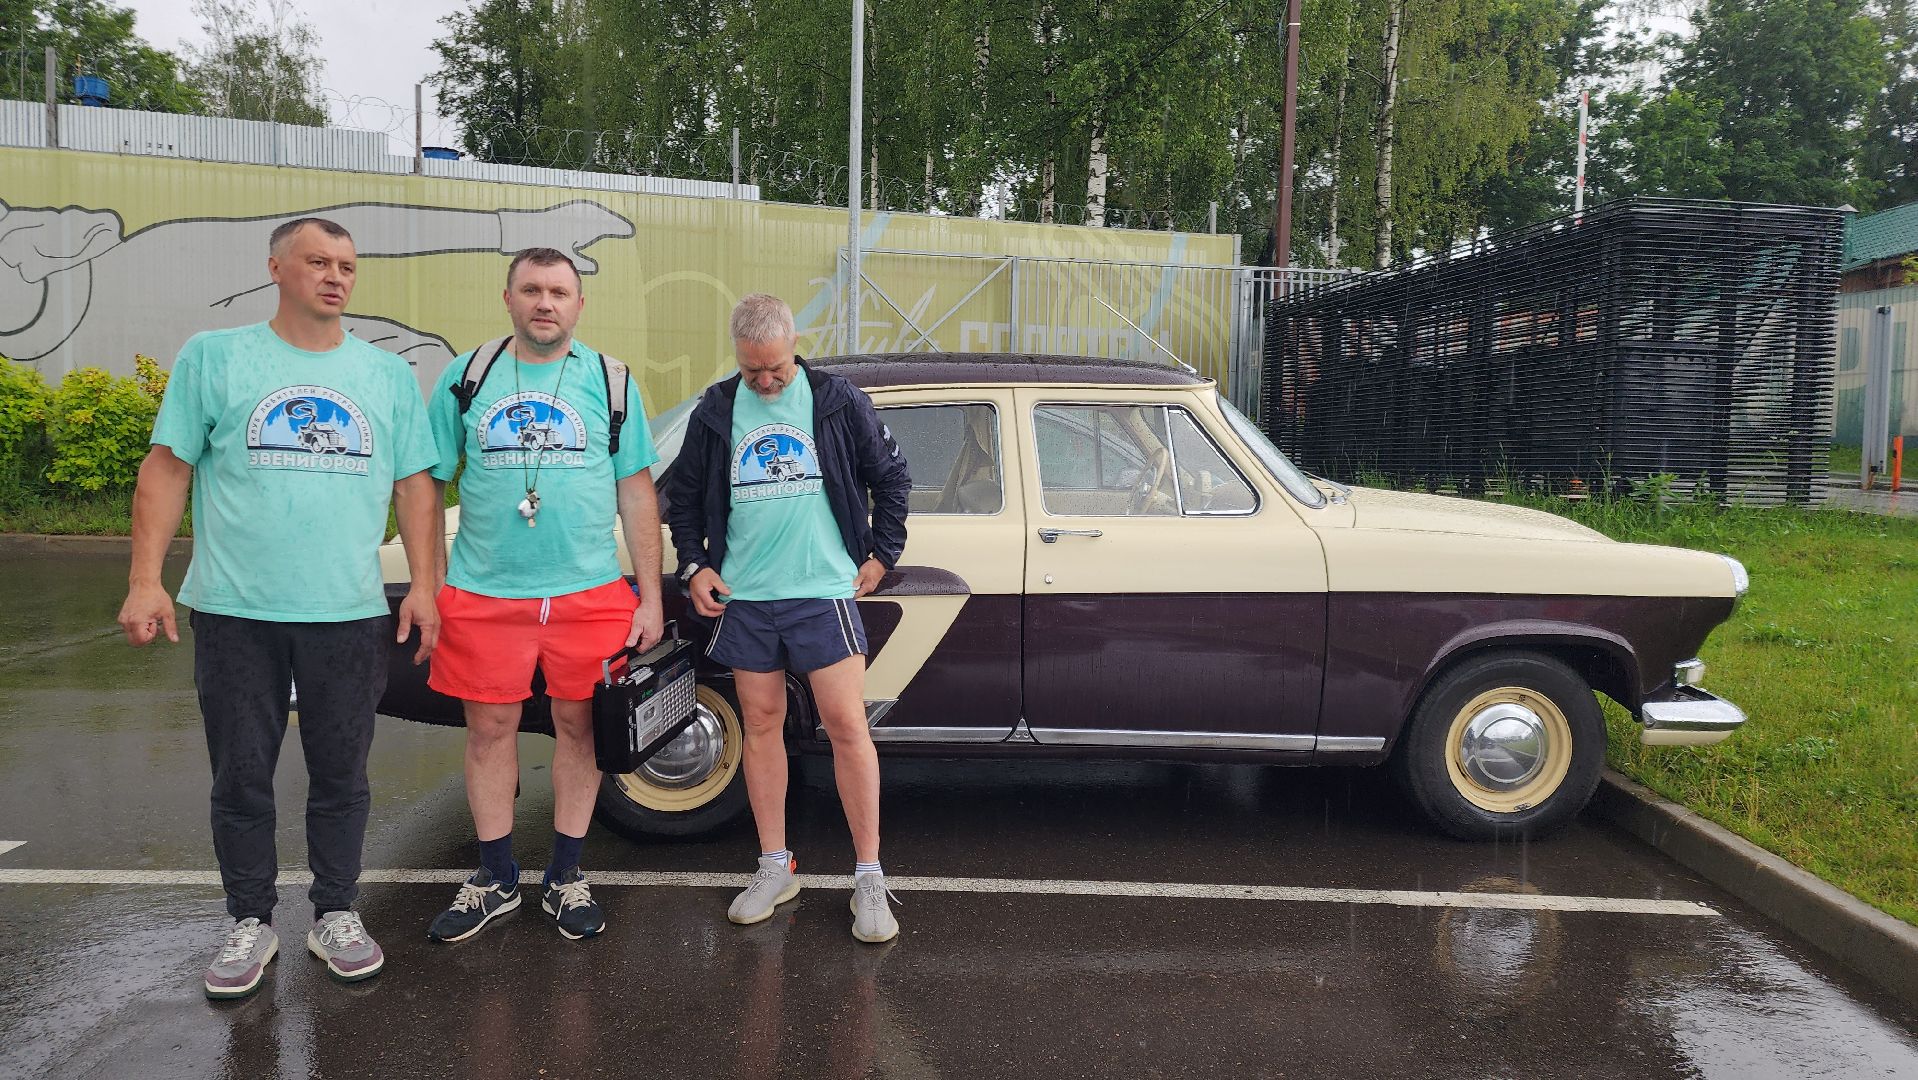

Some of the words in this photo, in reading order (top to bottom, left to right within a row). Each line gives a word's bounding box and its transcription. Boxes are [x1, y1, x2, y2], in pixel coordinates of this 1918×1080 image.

[250, 418, 260, 442] КЛУБ
[260, 387, 316, 414] ЛЮБИТЕЛЕЙ
[249, 452, 368, 474] ЗВЕНИГОРОД
[481, 452, 584, 466] ЗВЕНИГОРОД
[733, 480, 822, 500] ЗВЕНИГОРОД
